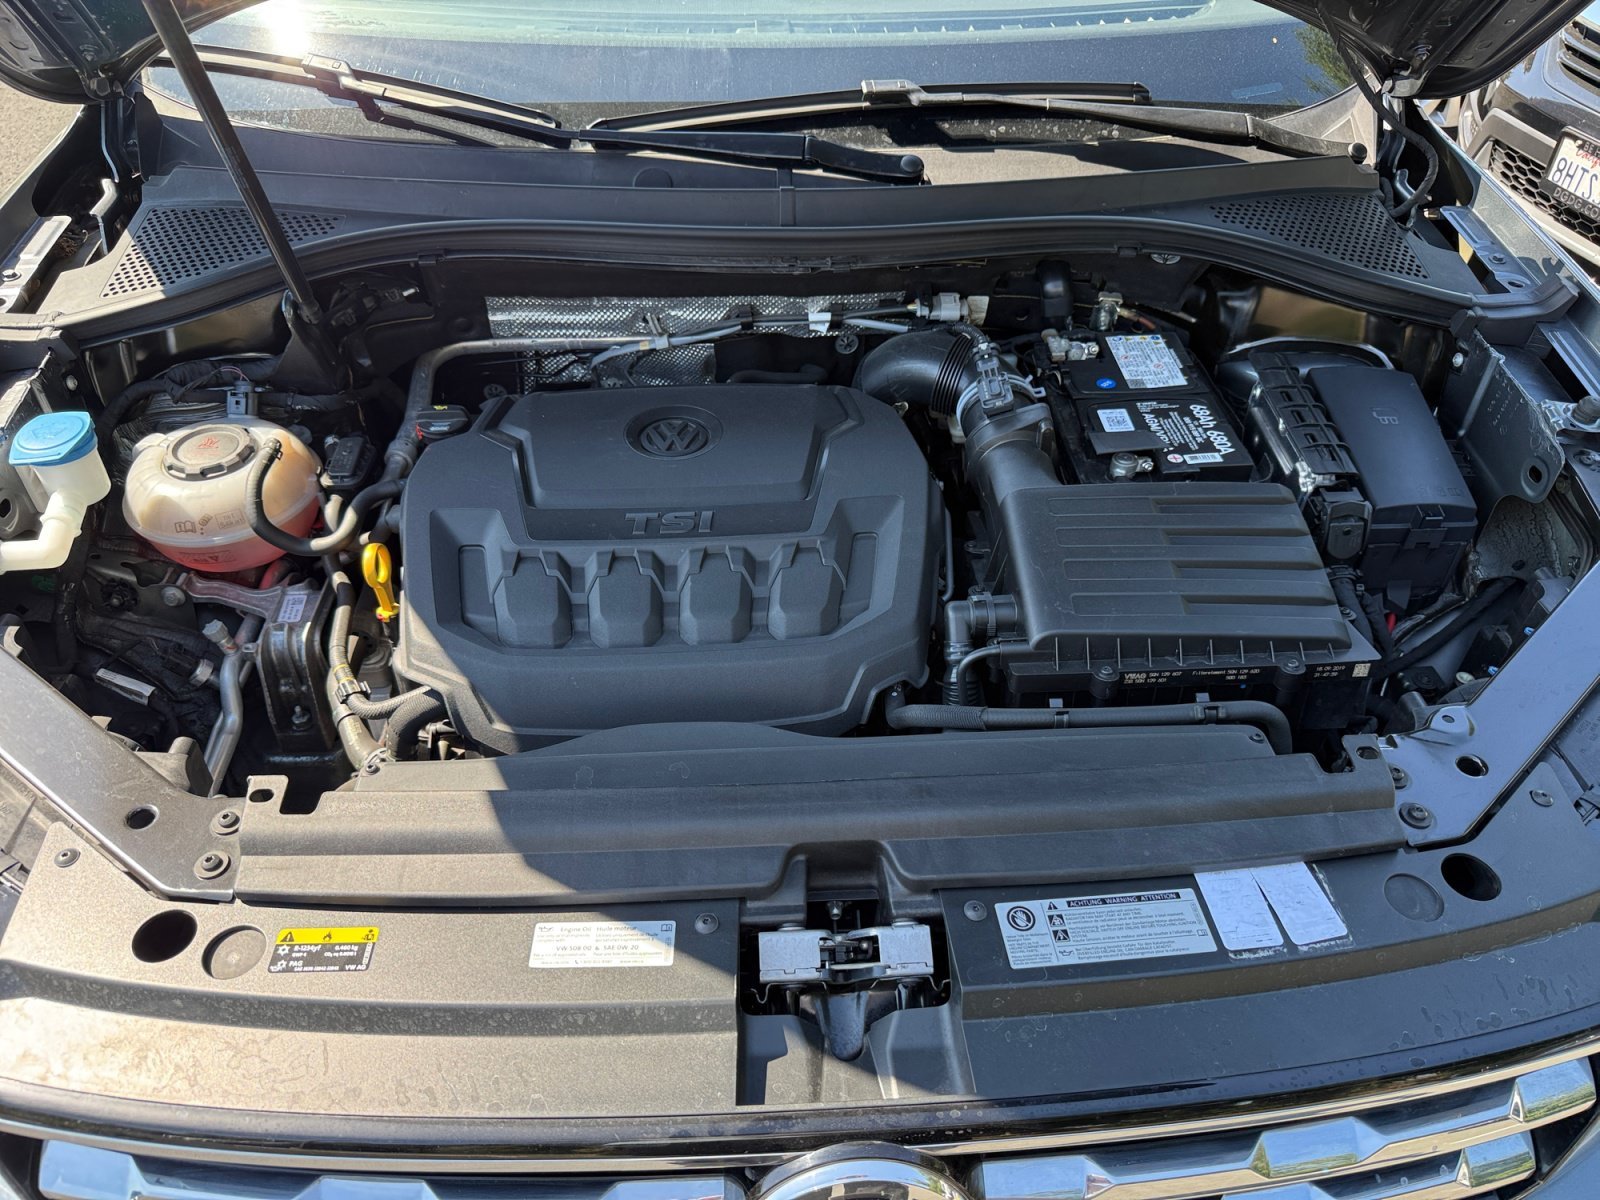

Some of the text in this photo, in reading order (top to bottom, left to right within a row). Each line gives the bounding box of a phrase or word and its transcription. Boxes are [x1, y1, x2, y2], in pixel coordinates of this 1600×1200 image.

[1551, 157, 1600, 205] 8HTS
[1553, 187, 1600, 218] DGDG.CO
[1190, 404, 1217, 428] 68Ah
[1206, 430, 1236, 455] 680A
[624, 510, 715, 534] TSI
[1070, 893, 1176, 907] ACHTUNG WARNING ATTENTION
